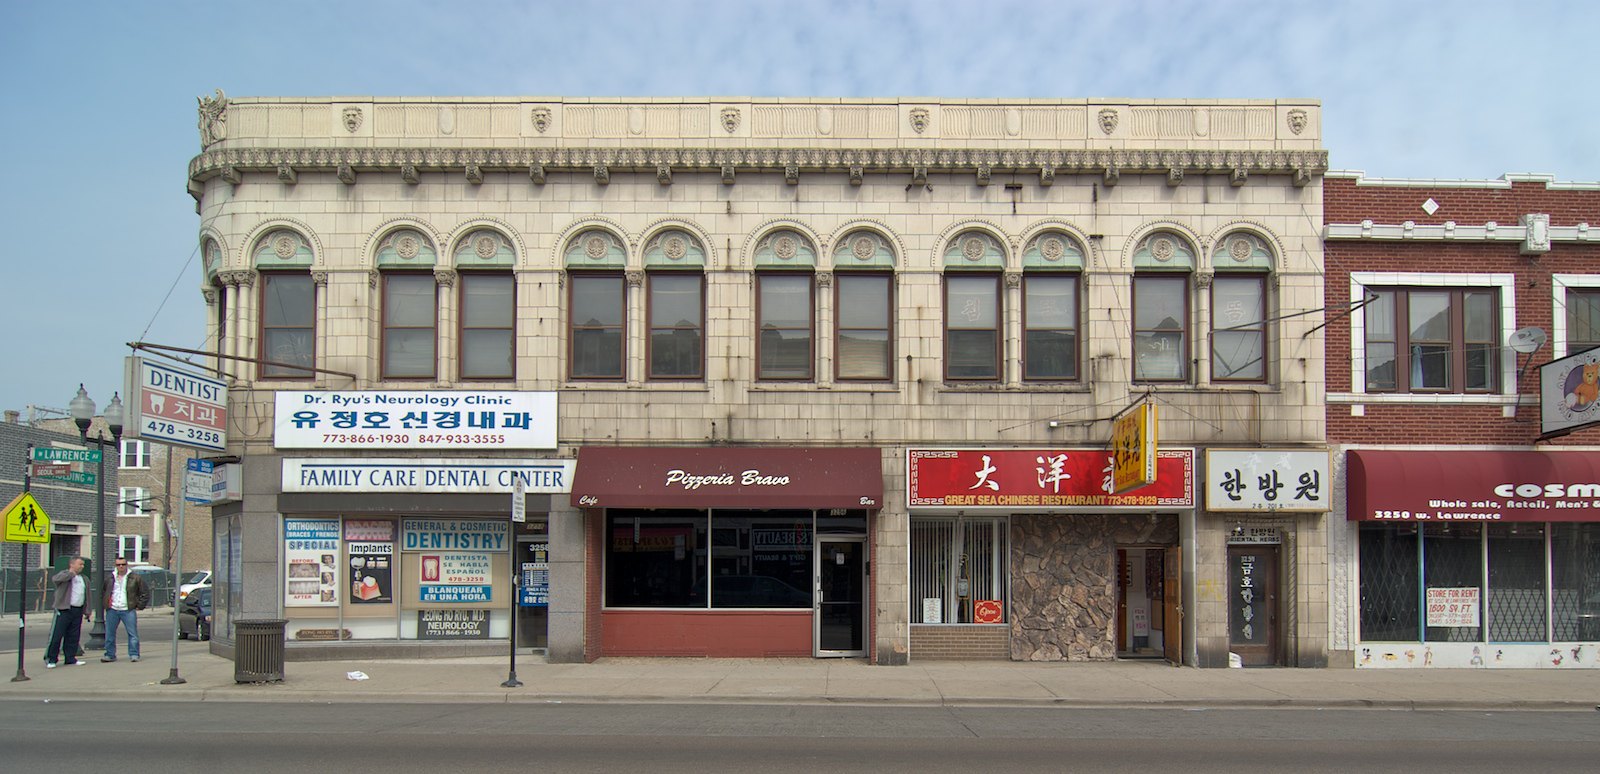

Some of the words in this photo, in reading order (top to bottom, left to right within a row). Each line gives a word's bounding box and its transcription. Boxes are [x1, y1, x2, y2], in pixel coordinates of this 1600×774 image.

[150, 369, 221, 401] DENTIST
[304, 394, 326, 404] Dr.
[332, 394, 371, 407] Ryu's
[375, 394, 460, 407] Neurology
[464, 395, 512, 405] Clinic
[174, 401, 218, 425] 치과
[322, 434, 410, 444] 773-866-1930
[418, 434, 505, 444] 847-933-3555
[44, 449, 91, 461] LAWRENCE
[37, 468, 54, 476] SEOUL
[301, 469, 362, 486] FAMILY
[370, 469, 417, 487] CARE
[425, 470, 490, 487] DENTAL
[666, 469, 735, 490] Pizzeria
[741, 470, 790, 486] Bravo
[1219, 468, 1320, 501] 한방원
[579, 495, 598, 506] Cafe
[859, 496, 876, 506] Bar
[944, 495, 976, 505] GREAT
[977, 495, 997, 505] SEA
[998, 495, 1040, 505] CHINESE
[1041, 494, 1106, 505] RESTAURANT
[1429, 500, 1467, 508] Whole
[1471, 500, 1502, 509] sale,
[1506, 500, 1551, 509] Retail,
[1555, 500, 1589, 508] Men's
[1374, 510, 1411, 519] 3250
[1437, 511, 1501, 520] Lawrence
[287, 521, 339, 531] ORTHODONTICS
[405, 521, 447, 531] GENERAL
[449, 522, 457, 531] &
[460, 522, 507, 532] COSMETIC
[289, 540, 337, 550] SPECIAL
[407, 532, 504, 549] DENTISTRY
[351, 543, 392, 554] Implants
[530, 544, 549, 552] 3258
[1427, 589, 1447, 598] STORE
[1448, 589, 1460, 598] FOR
[1461, 589, 1477, 598] RENT
[979, 606, 996, 617] Open
[427, 621, 480, 630] NEUROLOGY
